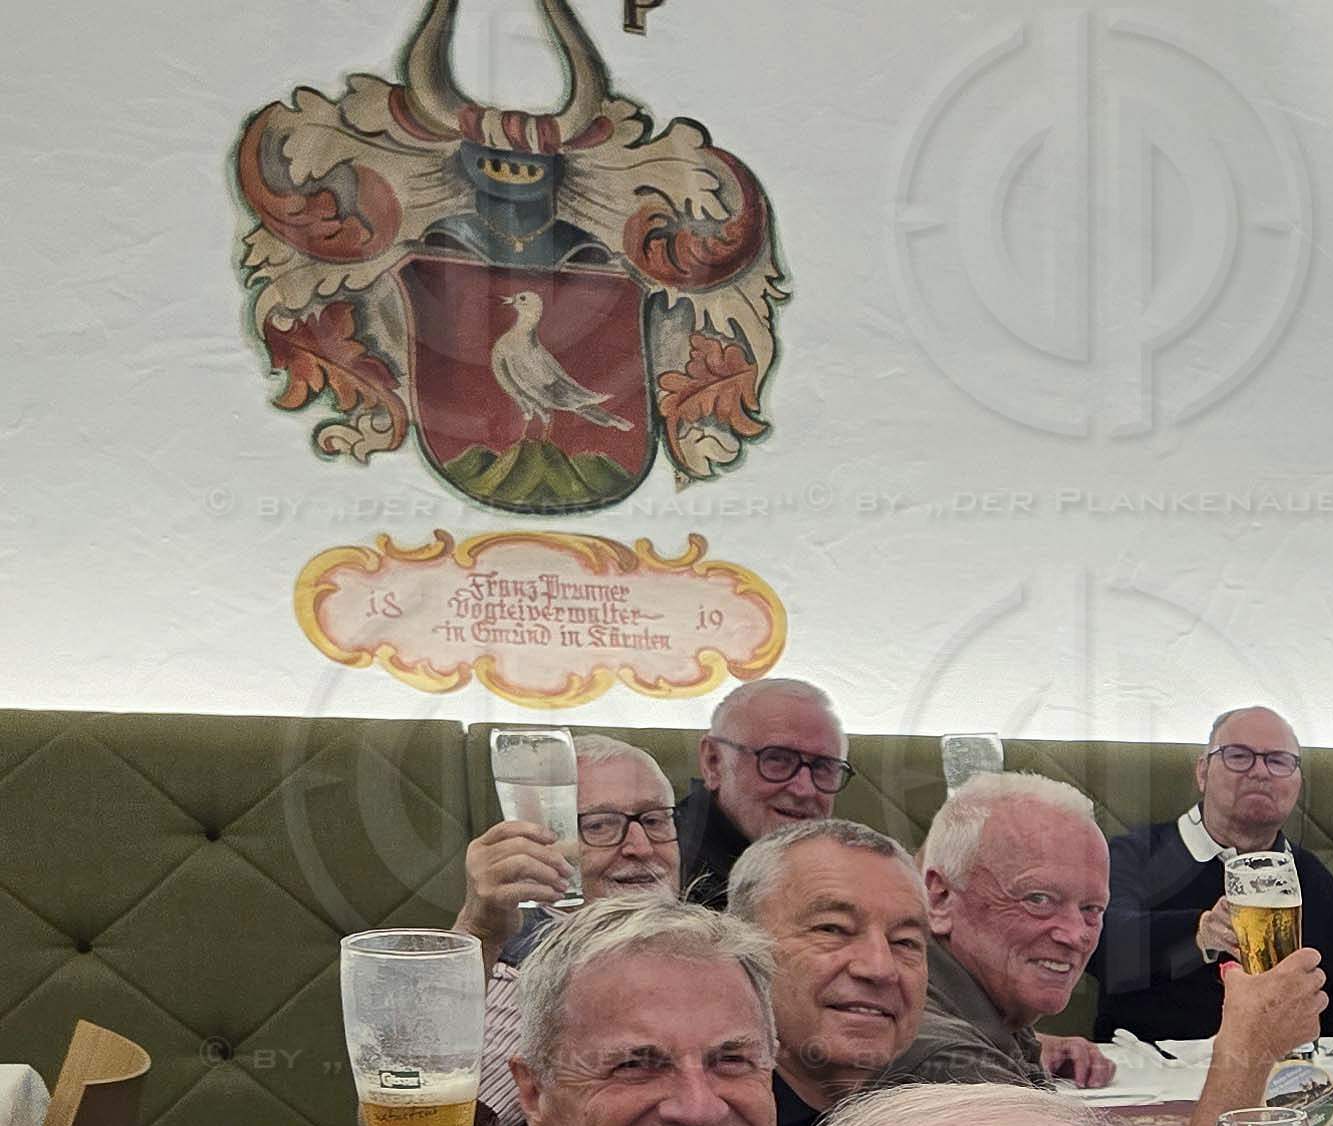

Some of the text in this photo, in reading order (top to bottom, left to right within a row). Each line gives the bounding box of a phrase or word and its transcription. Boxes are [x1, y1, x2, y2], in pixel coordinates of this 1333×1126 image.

[457, 571, 631, 607] Franz Prunner
[560, 624, 582, 648] in
